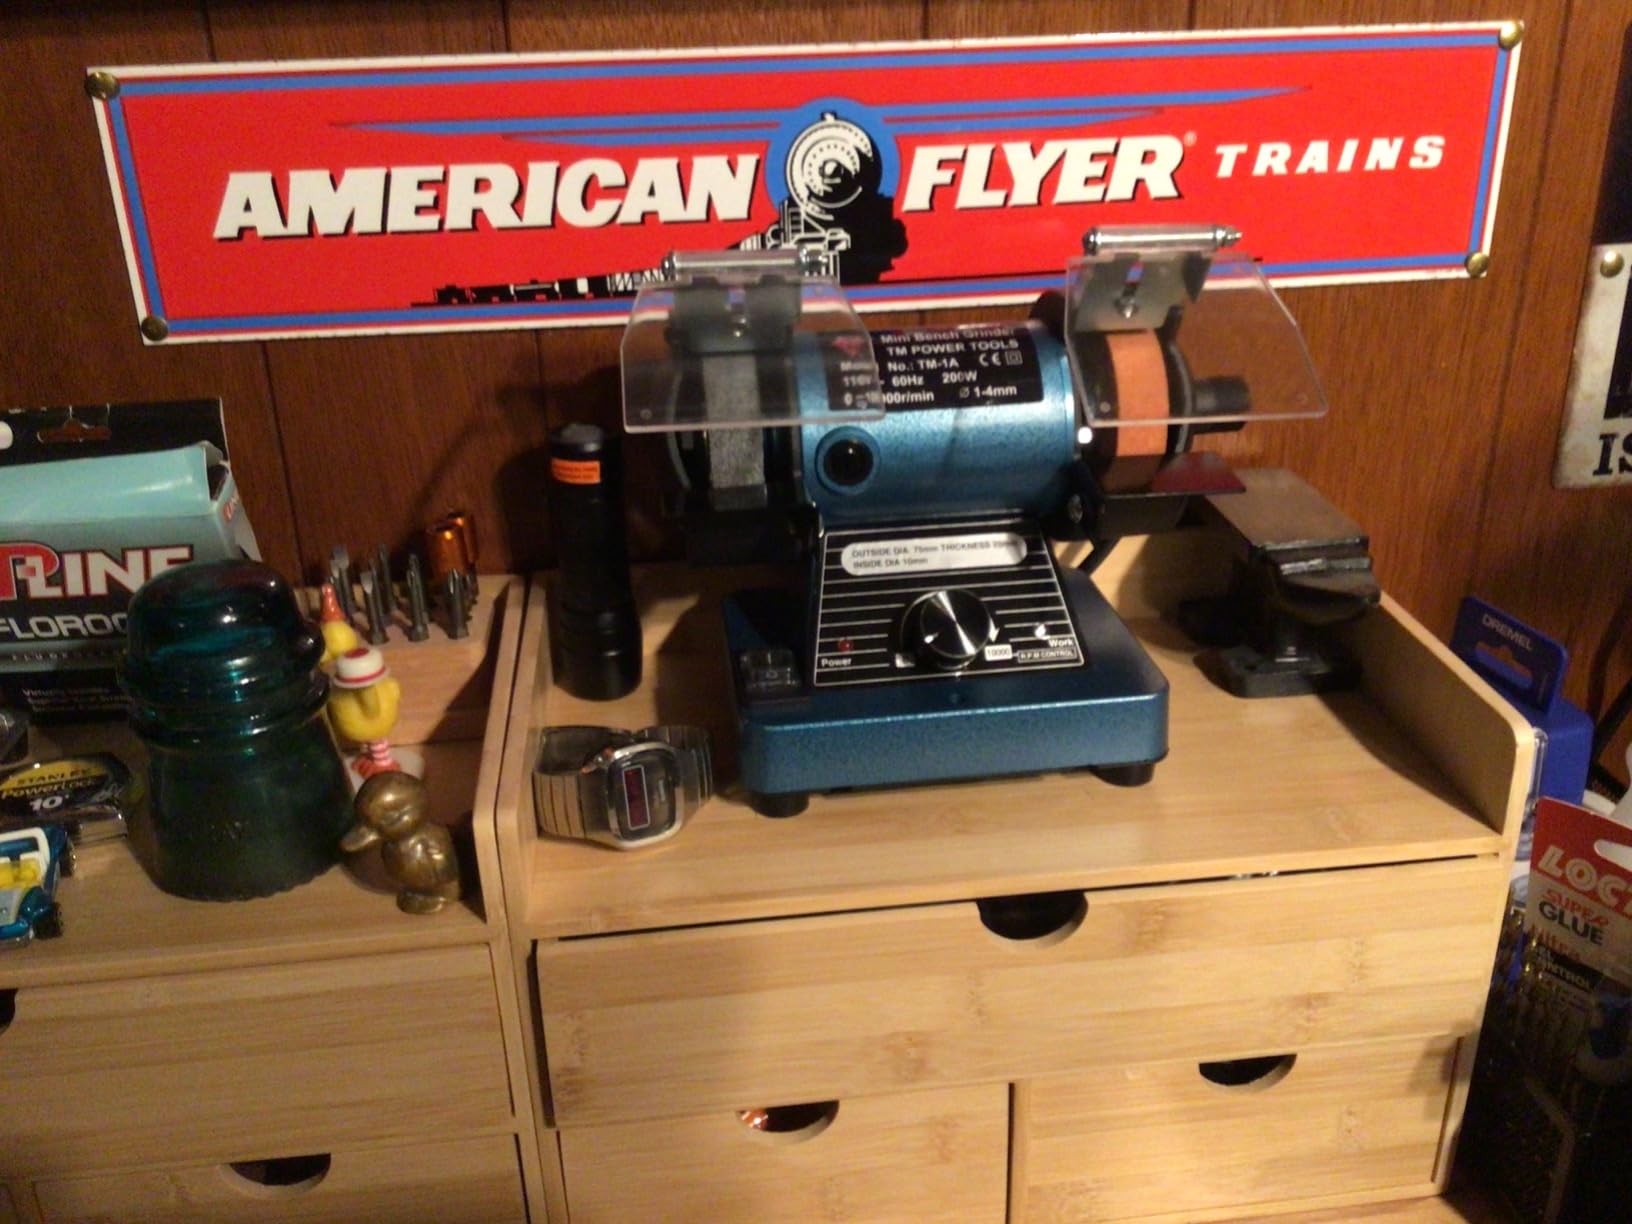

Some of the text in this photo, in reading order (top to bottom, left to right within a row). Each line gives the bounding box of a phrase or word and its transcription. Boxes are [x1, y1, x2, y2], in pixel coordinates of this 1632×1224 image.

[212, 134, 1447, 240] AMERICAN FLYER TRAINS
[880, 328, 1017, 345] Mini Bench Grinder
[886, 339, 1020, 357] TM POWER TOOLS
[917, 357, 961, 370] TM-1A
[892, 373, 925, 387] 60Hz
[942, 370, 979, 384] 200W
[974, 384, 1018, 398] 1-4mm
[851, 547, 891, 558] OUTSIDE
[941, 541, 991, 553] THICKNESS
[853, 559, 884, 569] INSIDE
[1481, 613, 1534, 652] DREMEL
[1047, 638, 1074, 648] Work
[1041, 649, 1074, 659] CONTROL
[821, 657, 853, 669] Power
[1541, 888, 1610, 926] SUPER
[1538, 900, 1604, 946] GLUE
